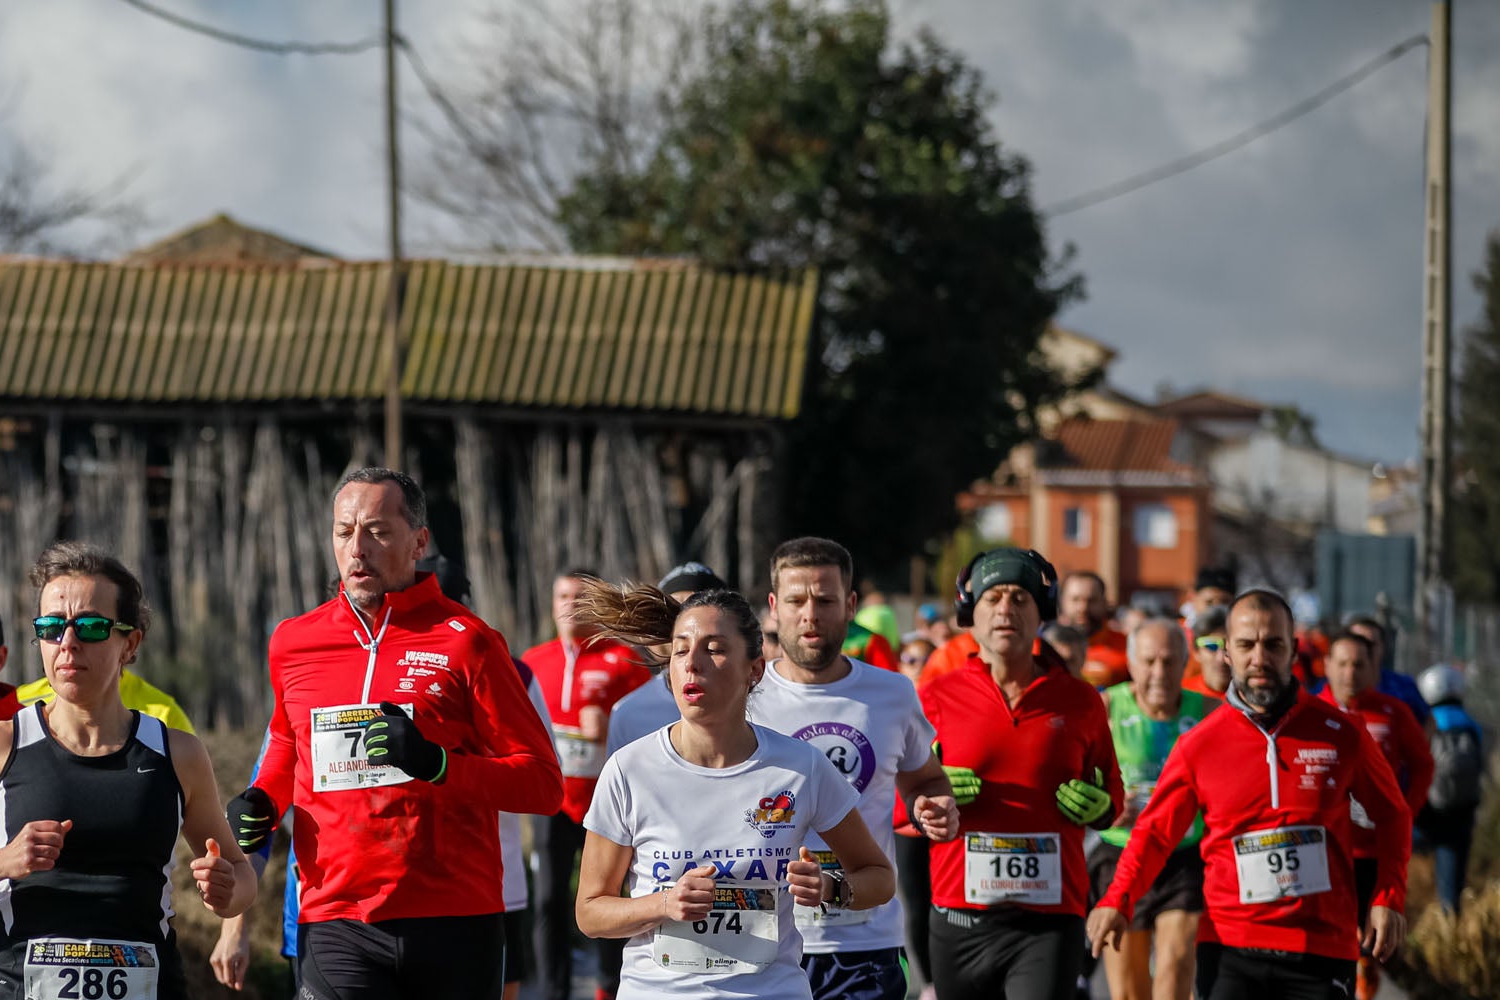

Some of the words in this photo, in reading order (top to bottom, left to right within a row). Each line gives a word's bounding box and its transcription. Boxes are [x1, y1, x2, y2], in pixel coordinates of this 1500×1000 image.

[337, 709, 374, 718] CARRERA
[653, 850, 694, 860] CLUB
[702, 847, 792, 859] ATLETISMO
[1267, 849, 1300, 874] 95
[989, 856, 1040, 879] 168
[692, 912, 743, 935] 674
[64, 944, 110, 952] CARRERA
[714, 957, 738, 965] olimpo
[58, 967, 128, 1000] 286
